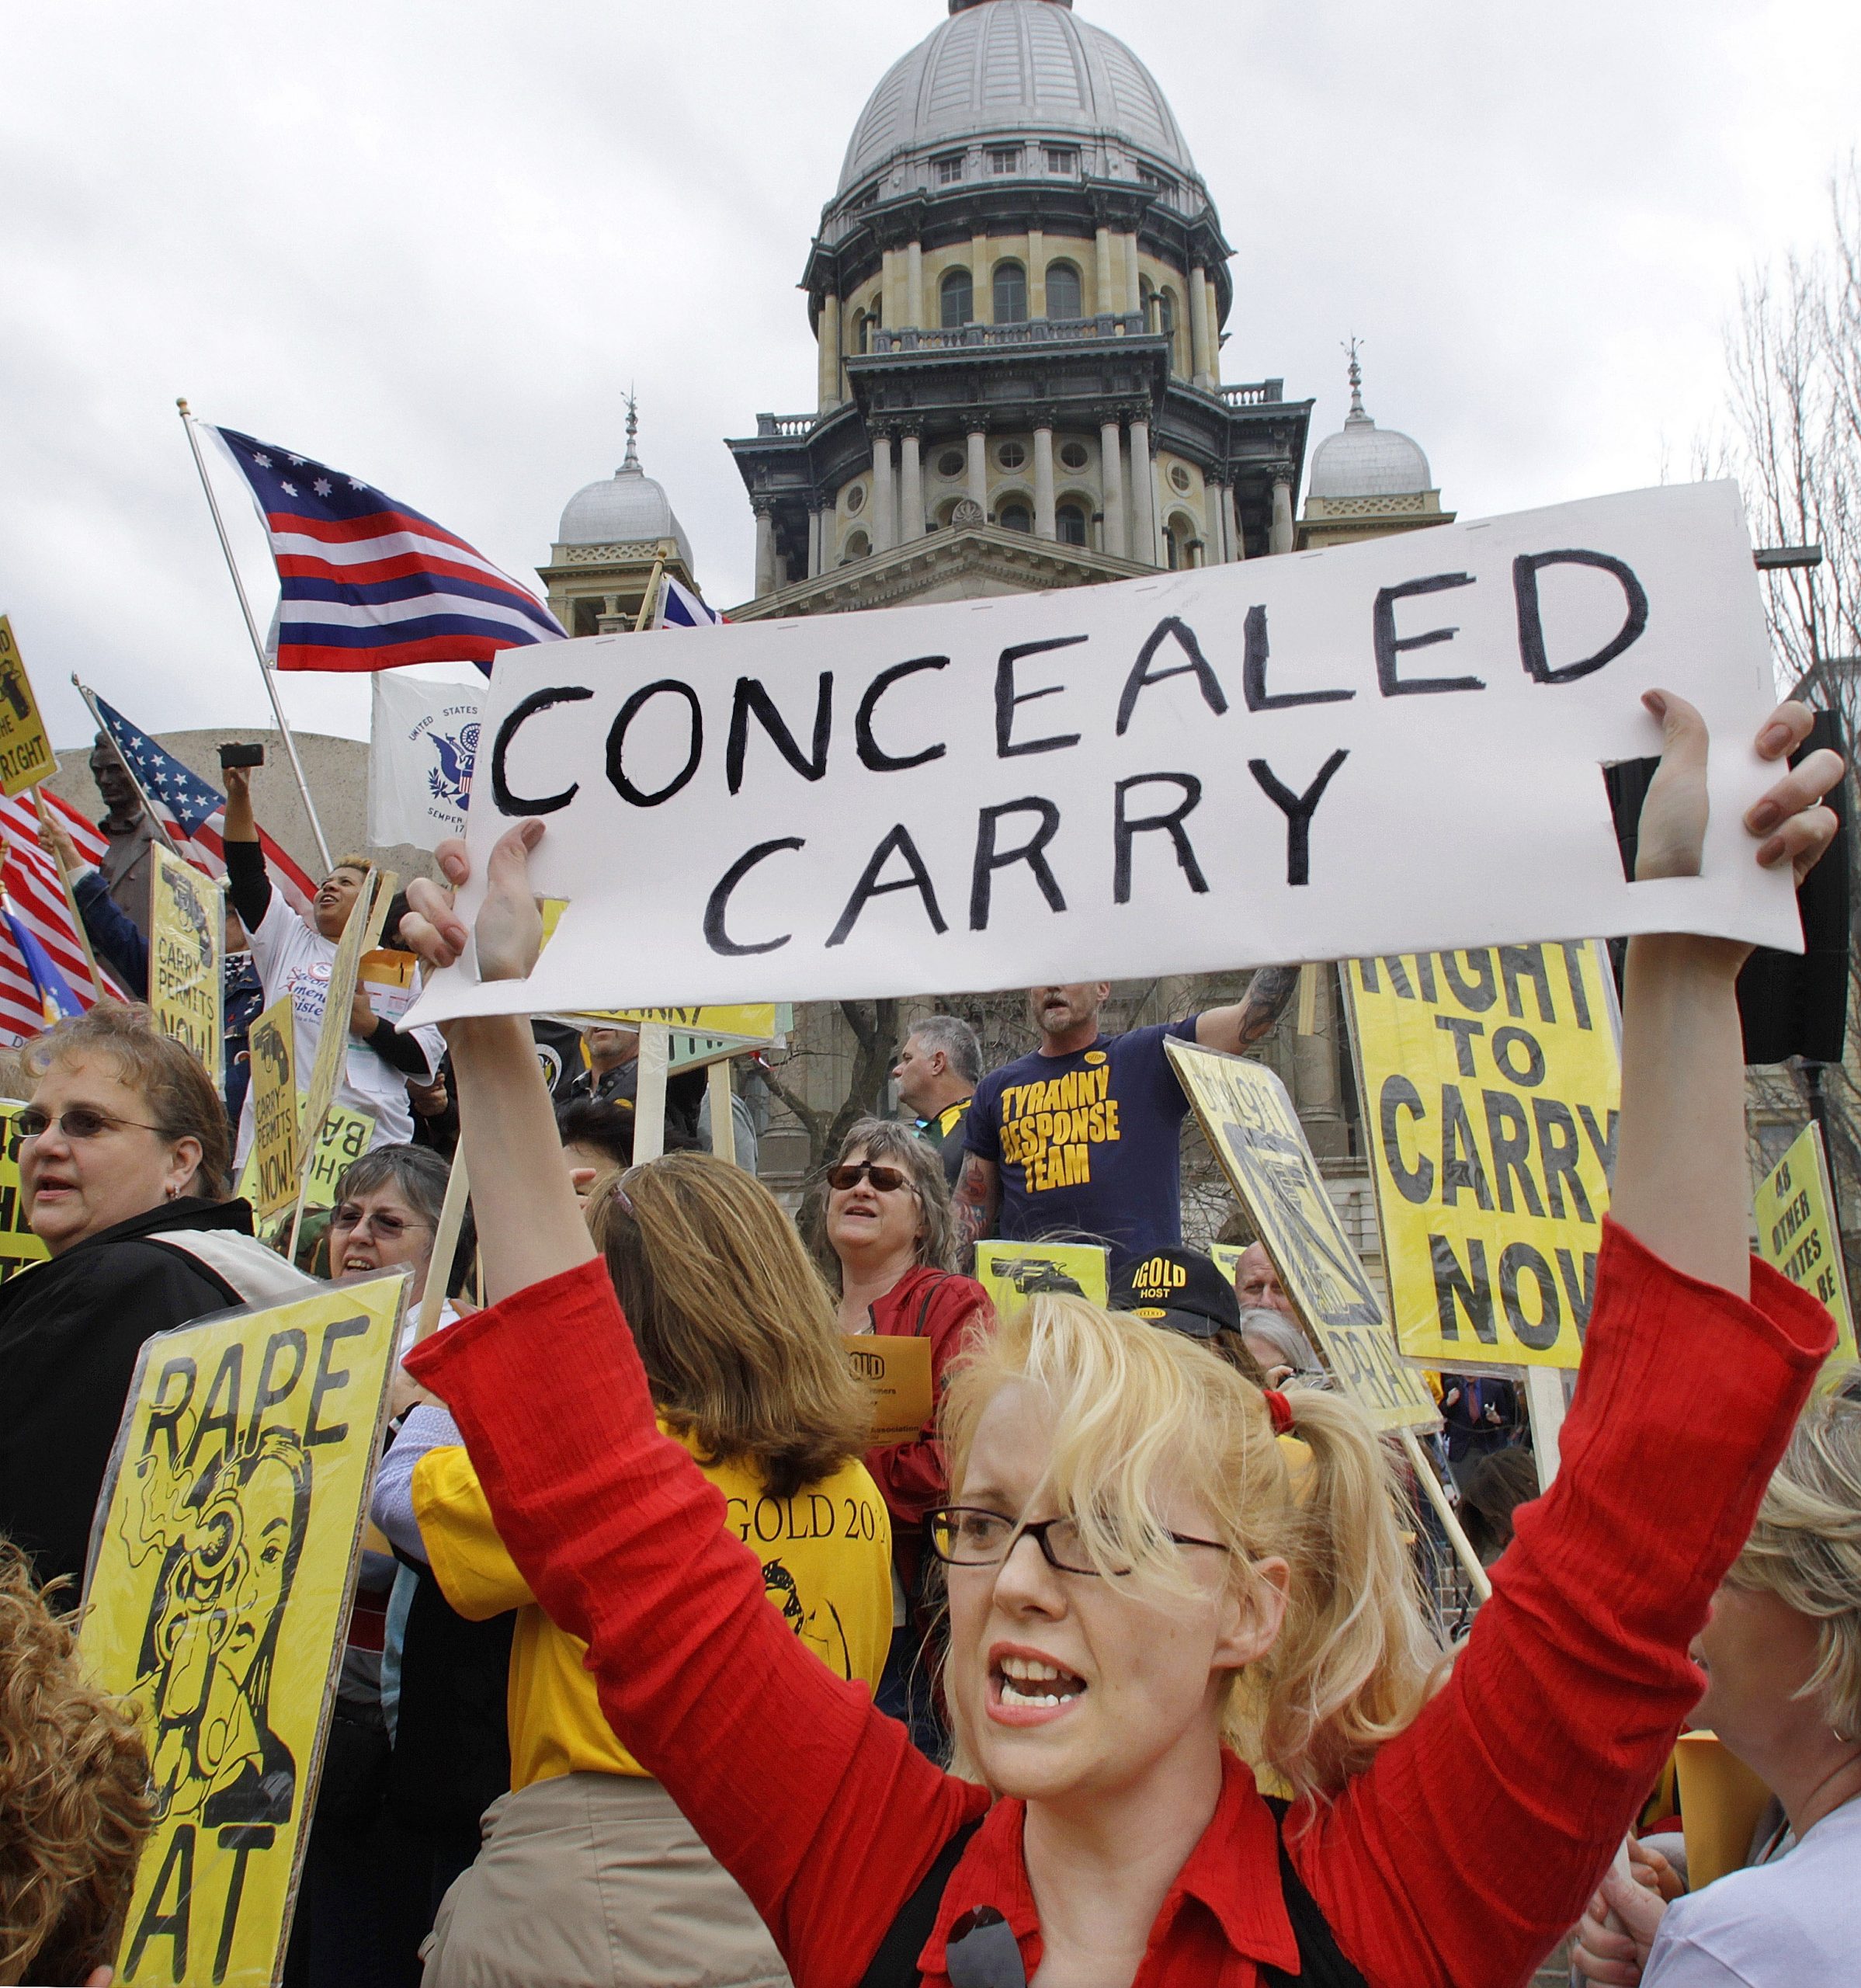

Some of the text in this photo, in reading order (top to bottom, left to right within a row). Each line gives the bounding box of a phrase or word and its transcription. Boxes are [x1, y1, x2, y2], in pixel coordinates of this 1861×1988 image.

[491, 548, 1649, 816] CONCEALED
[408, 706, 478, 741] UNITED STATES
[0, 735, 47, 781] RIGHT
[427, 807, 464, 824] SEMPER
[703, 749, 1350, 956] CARRY
[159, 968, 214, 1021] PERMITS
[286, 966, 328, 989] Secon
[1434, 1014, 1546, 1087] TO
[1001, 1065, 1110, 1123] TYRANNY
[1235, 1076, 1295, 1140] 911
[257, 1108, 293, 1149] PERMITS
[999, 1100, 1120, 1165] RESPONSE
[1380, 1074, 1620, 1224] CARRY
[260, 1136, 295, 1204] NOW!
[1021, 1143, 1090, 1194] TEAM
[1772, 1189, 1811, 1256] OTHER
[1131, 1256, 1186, 1289] IGOLD
[1781, 1228, 1821, 1281] TATES
[1140, 1288, 1171, 1299] HOST
[1817, 1265, 1836, 1305] BE
[138, 1313, 370, 1475] RAPE
[1327, 1329, 1422, 1409] PRAY
[844, 1497, 884, 1544] 20
